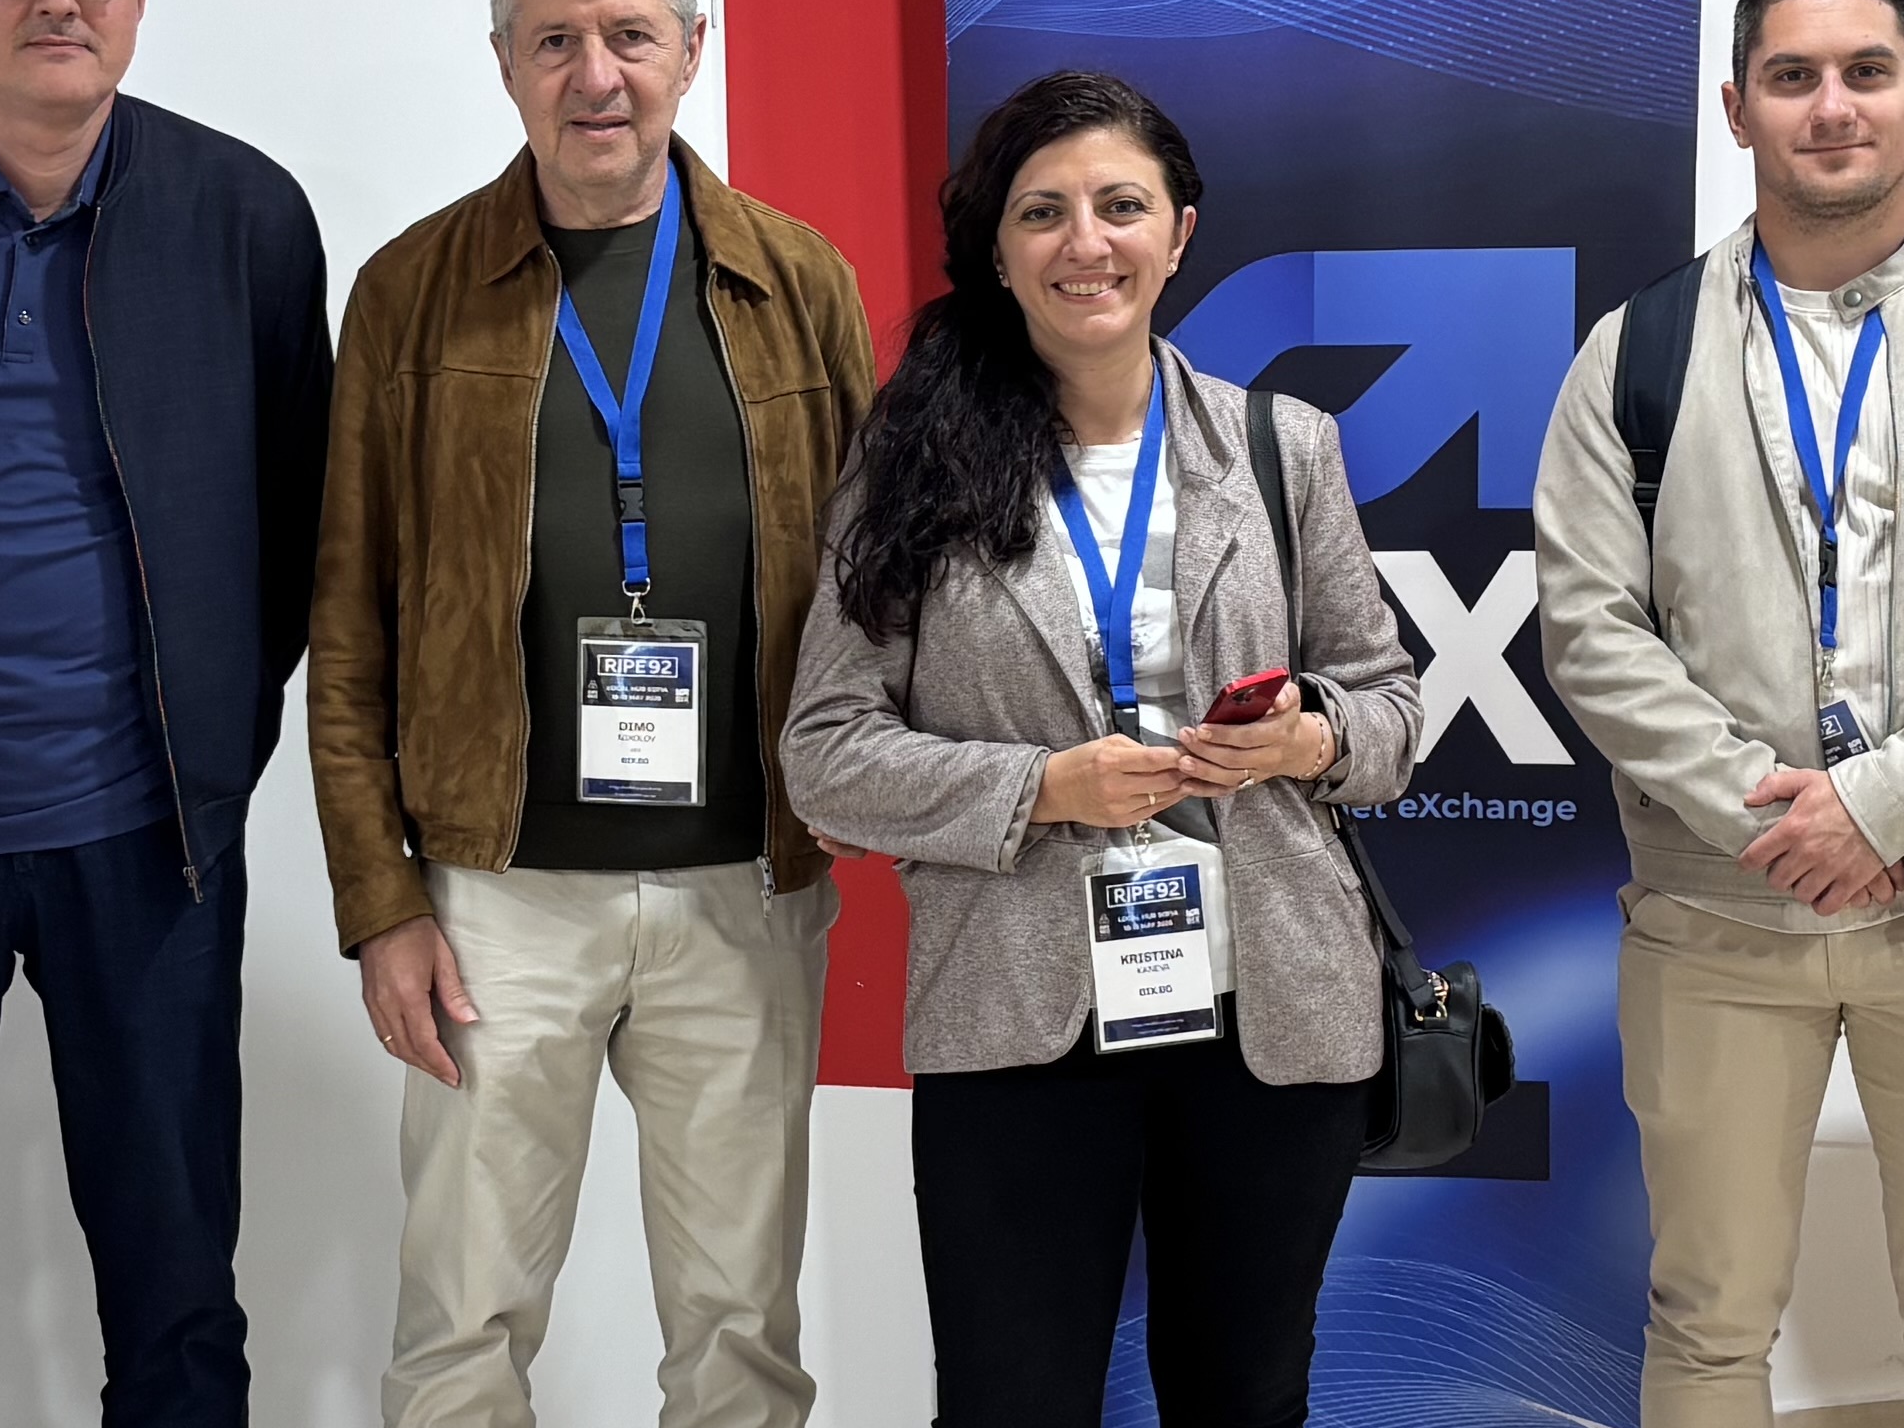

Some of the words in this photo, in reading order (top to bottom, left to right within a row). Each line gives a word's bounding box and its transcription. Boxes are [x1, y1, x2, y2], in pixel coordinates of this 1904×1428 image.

[618, 721, 655, 733] DIMO
[1398, 792, 1577, 827] eXchange
[1120, 948, 1184, 966] KRISTINA
